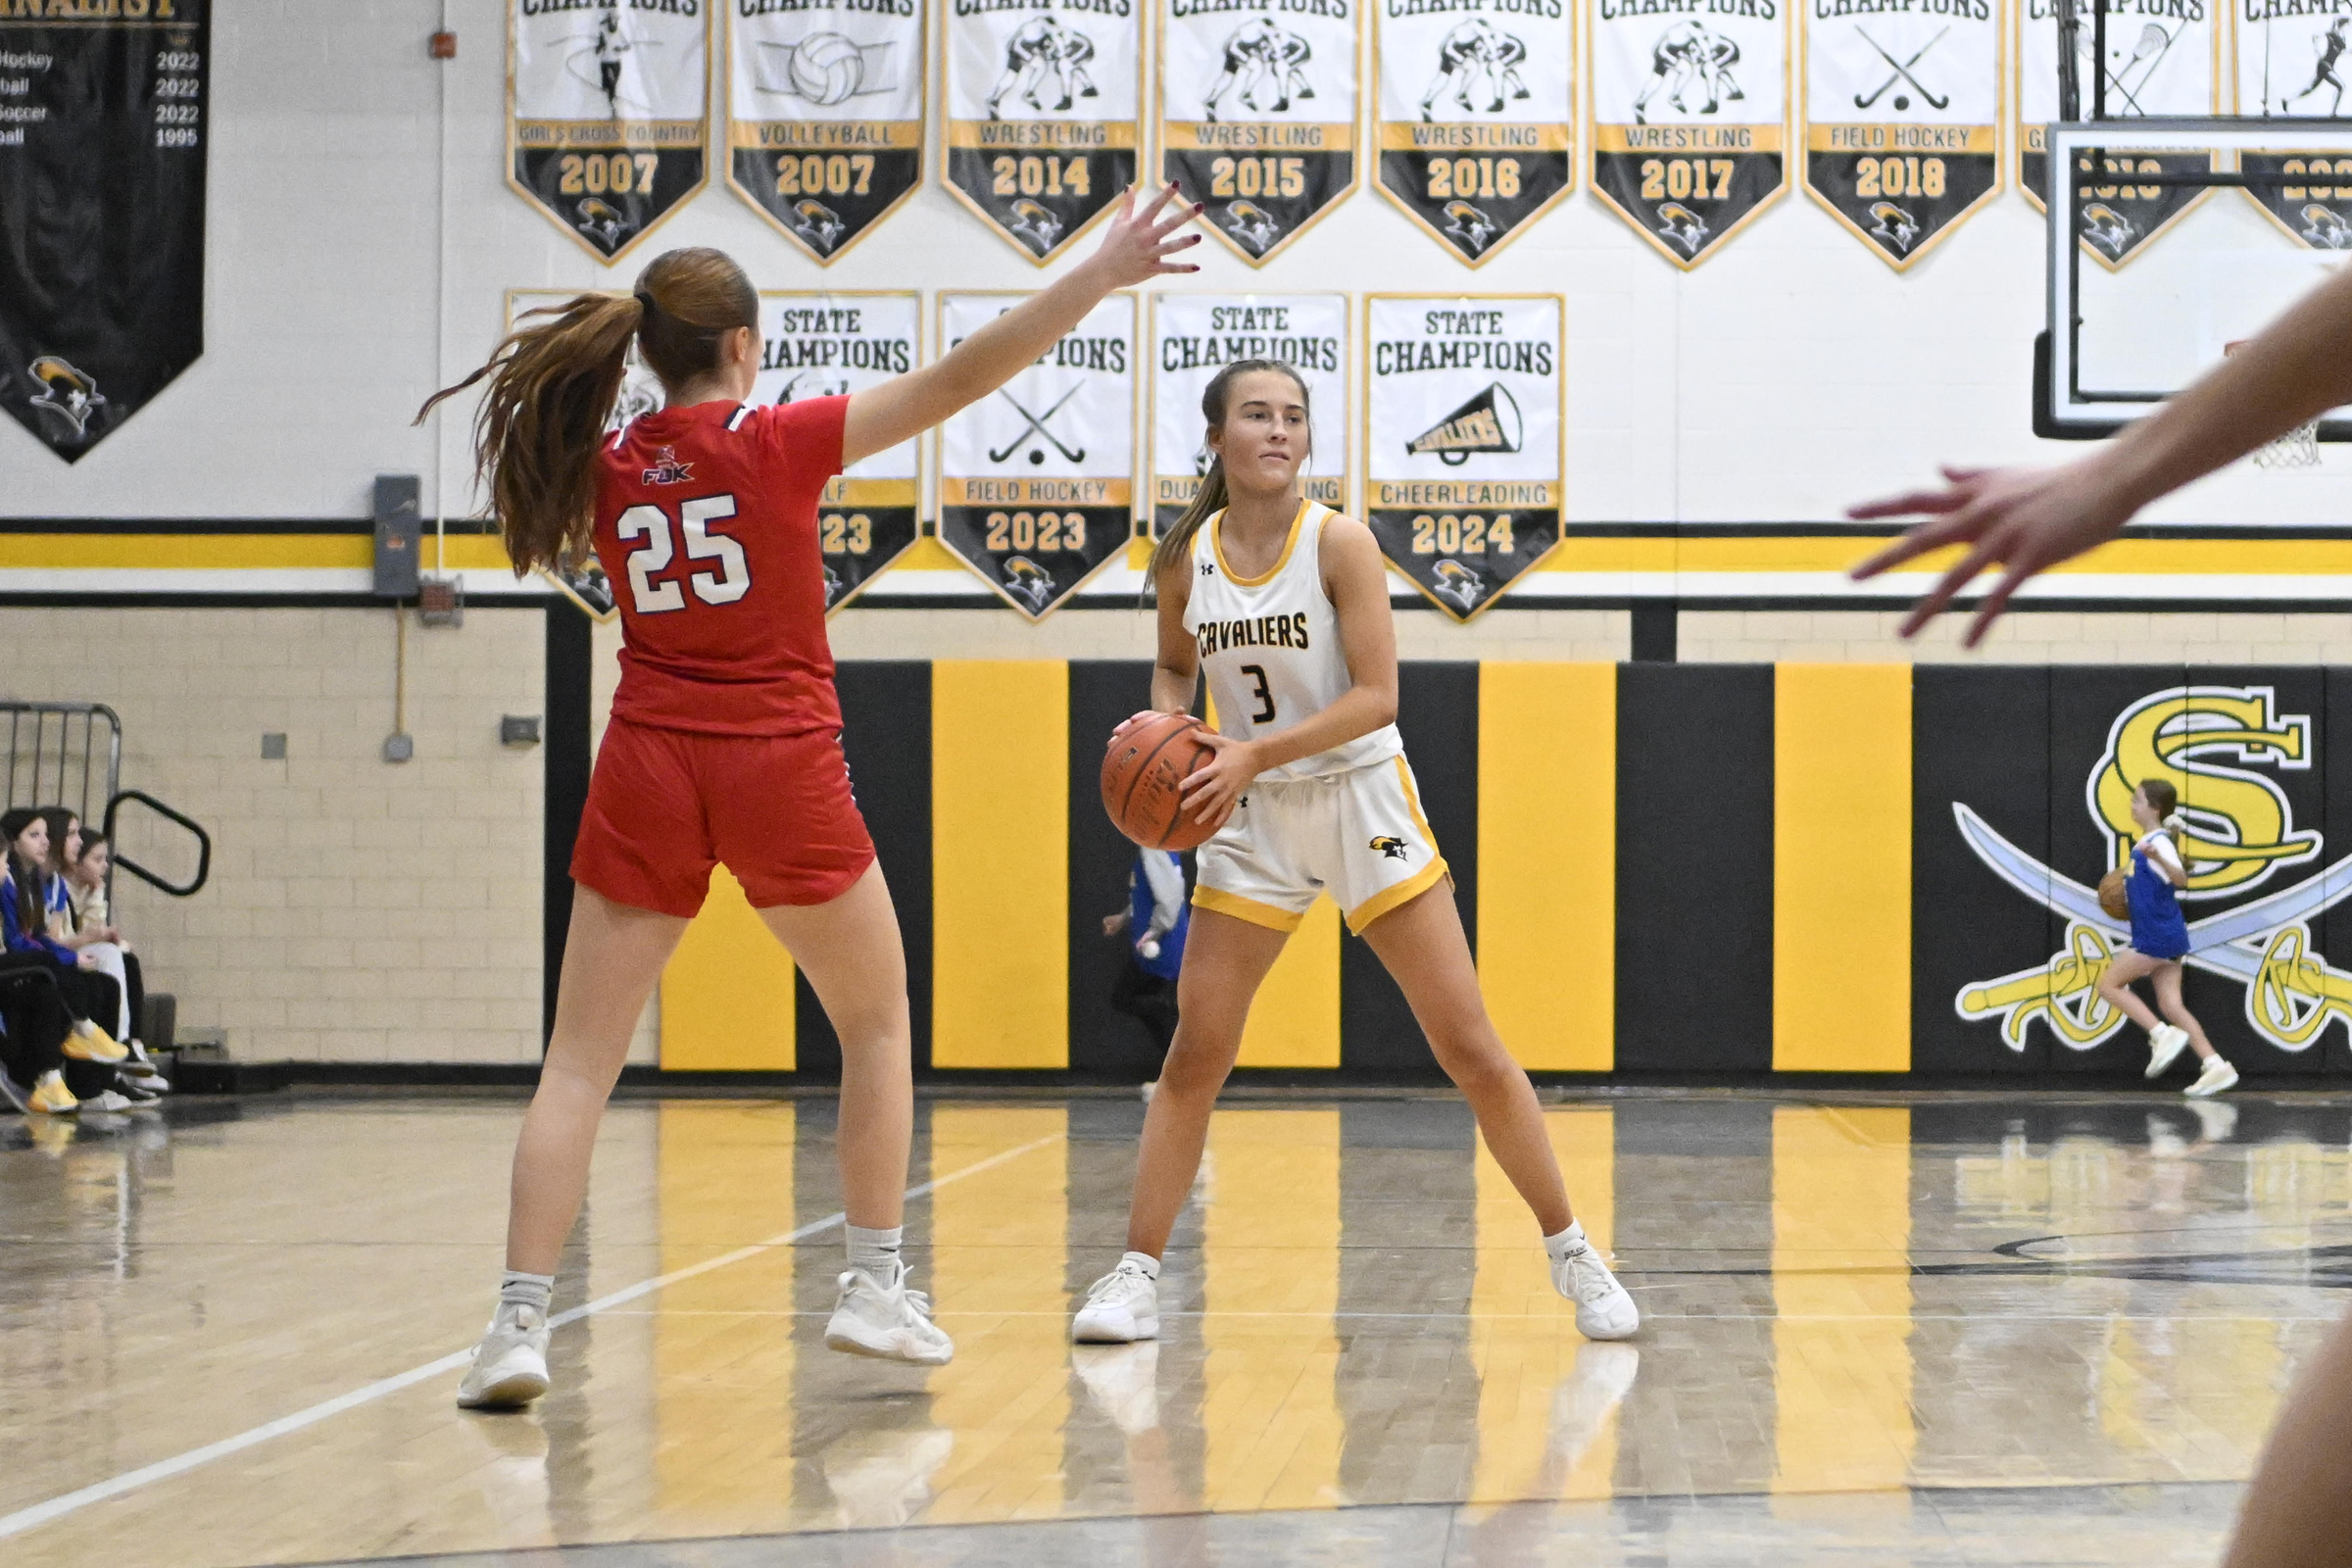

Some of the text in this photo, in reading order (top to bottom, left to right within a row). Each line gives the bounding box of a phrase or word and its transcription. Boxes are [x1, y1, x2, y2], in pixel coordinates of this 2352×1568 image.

[157, 51, 199, 72] 2022
[156, 77, 199, 97] 2022
[156, 104, 199, 123] 2022
[156, 127, 198, 147] 1995
[760, 125, 893, 145] VOLLEYBALL
[981, 124, 1106, 145] WRESTLING
[1196, 125, 1322, 146] WRESTLING
[1412, 126, 1539, 147] WRESTLING
[1625, 127, 1751, 148] WRESTLING
[1831, 127, 1970, 148] FIELD HOCKEY
[561, 154, 658, 194] 2007
[777, 155, 875, 195] 2007
[993, 156, 1091, 197] 2014
[1211, 157, 1304, 197] 2015
[1427, 158, 1521, 198] 2016
[1642, 159, 1735, 199] 2017
[1856, 157, 1946, 198] 2018
[784, 309, 861, 333] STATE
[1211, 307, 1289, 331] STATE
[1426, 311, 1503, 335] STATE
[760, 338, 909, 374] HAMPIONS
[1162, 336, 1339, 372] CHAMPIONS
[1376, 341, 1552, 376] CHAMPIONS
[825, 482, 846, 502] LF
[965, 481, 1107, 501] FIELD HOCKEY
[1160, 480, 1200, 500] DUA
[1380, 484, 1549, 505] CHEERLEADING
[822, 513, 871, 556] 23
[986, 511, 1087, 552] 2023
[1412, 514, 1514, 555] 2024
[616, 494, 751, 614] 25
[1196, 611, 1309, 659] CAVALIERS
[1241, 663, 1276, 724] 3
